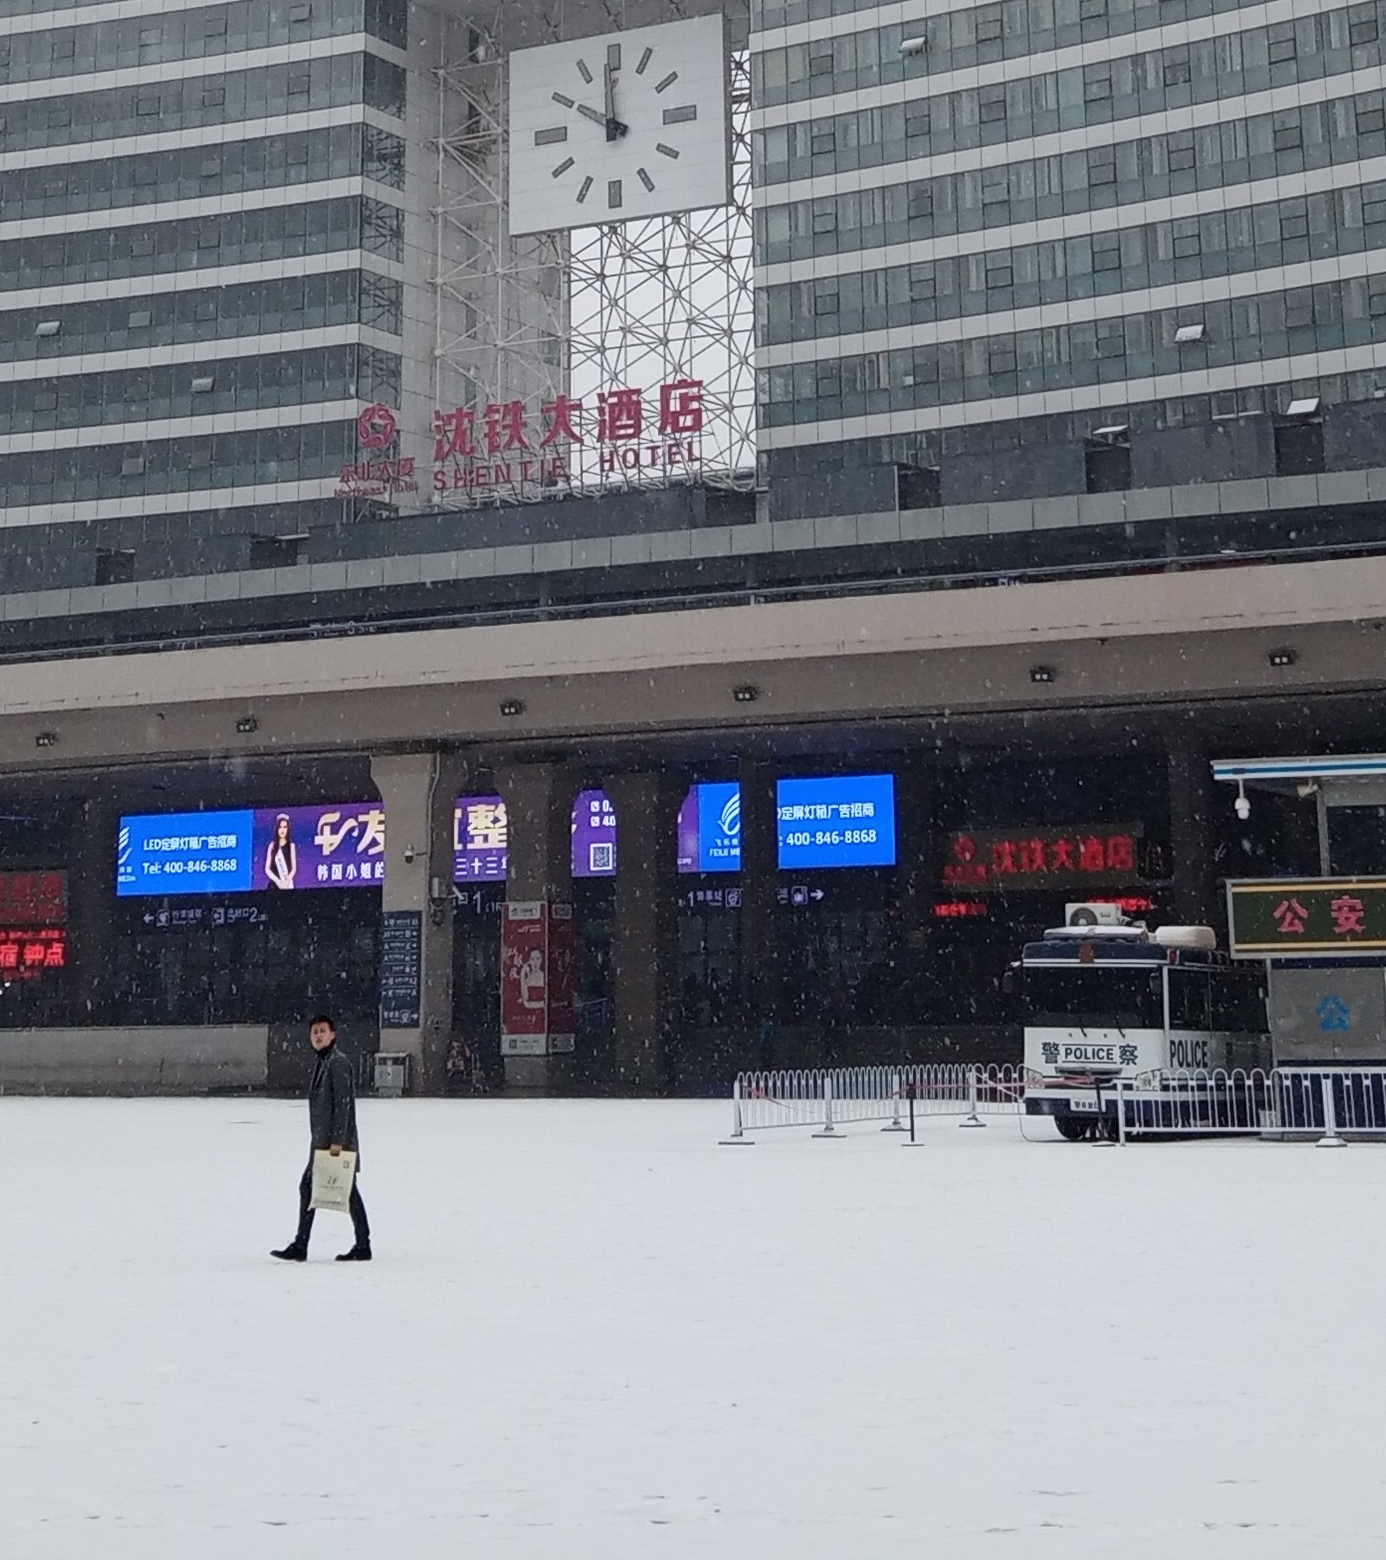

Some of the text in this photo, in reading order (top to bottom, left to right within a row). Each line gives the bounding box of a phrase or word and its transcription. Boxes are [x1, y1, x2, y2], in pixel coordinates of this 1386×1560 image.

[433, 378, 705, 462] 沈铁大酒店
[600, 441, 701, 472] HOTEL
[142, 861, 162, 874] Tel:
[163, 858, 238, 874] 400-846-8868
[1272, 895, 1367, 934] 公安
[1064, 1047, 1114, 1061] POLICE
[1169, 1039, 1209, 1069] POLICE
